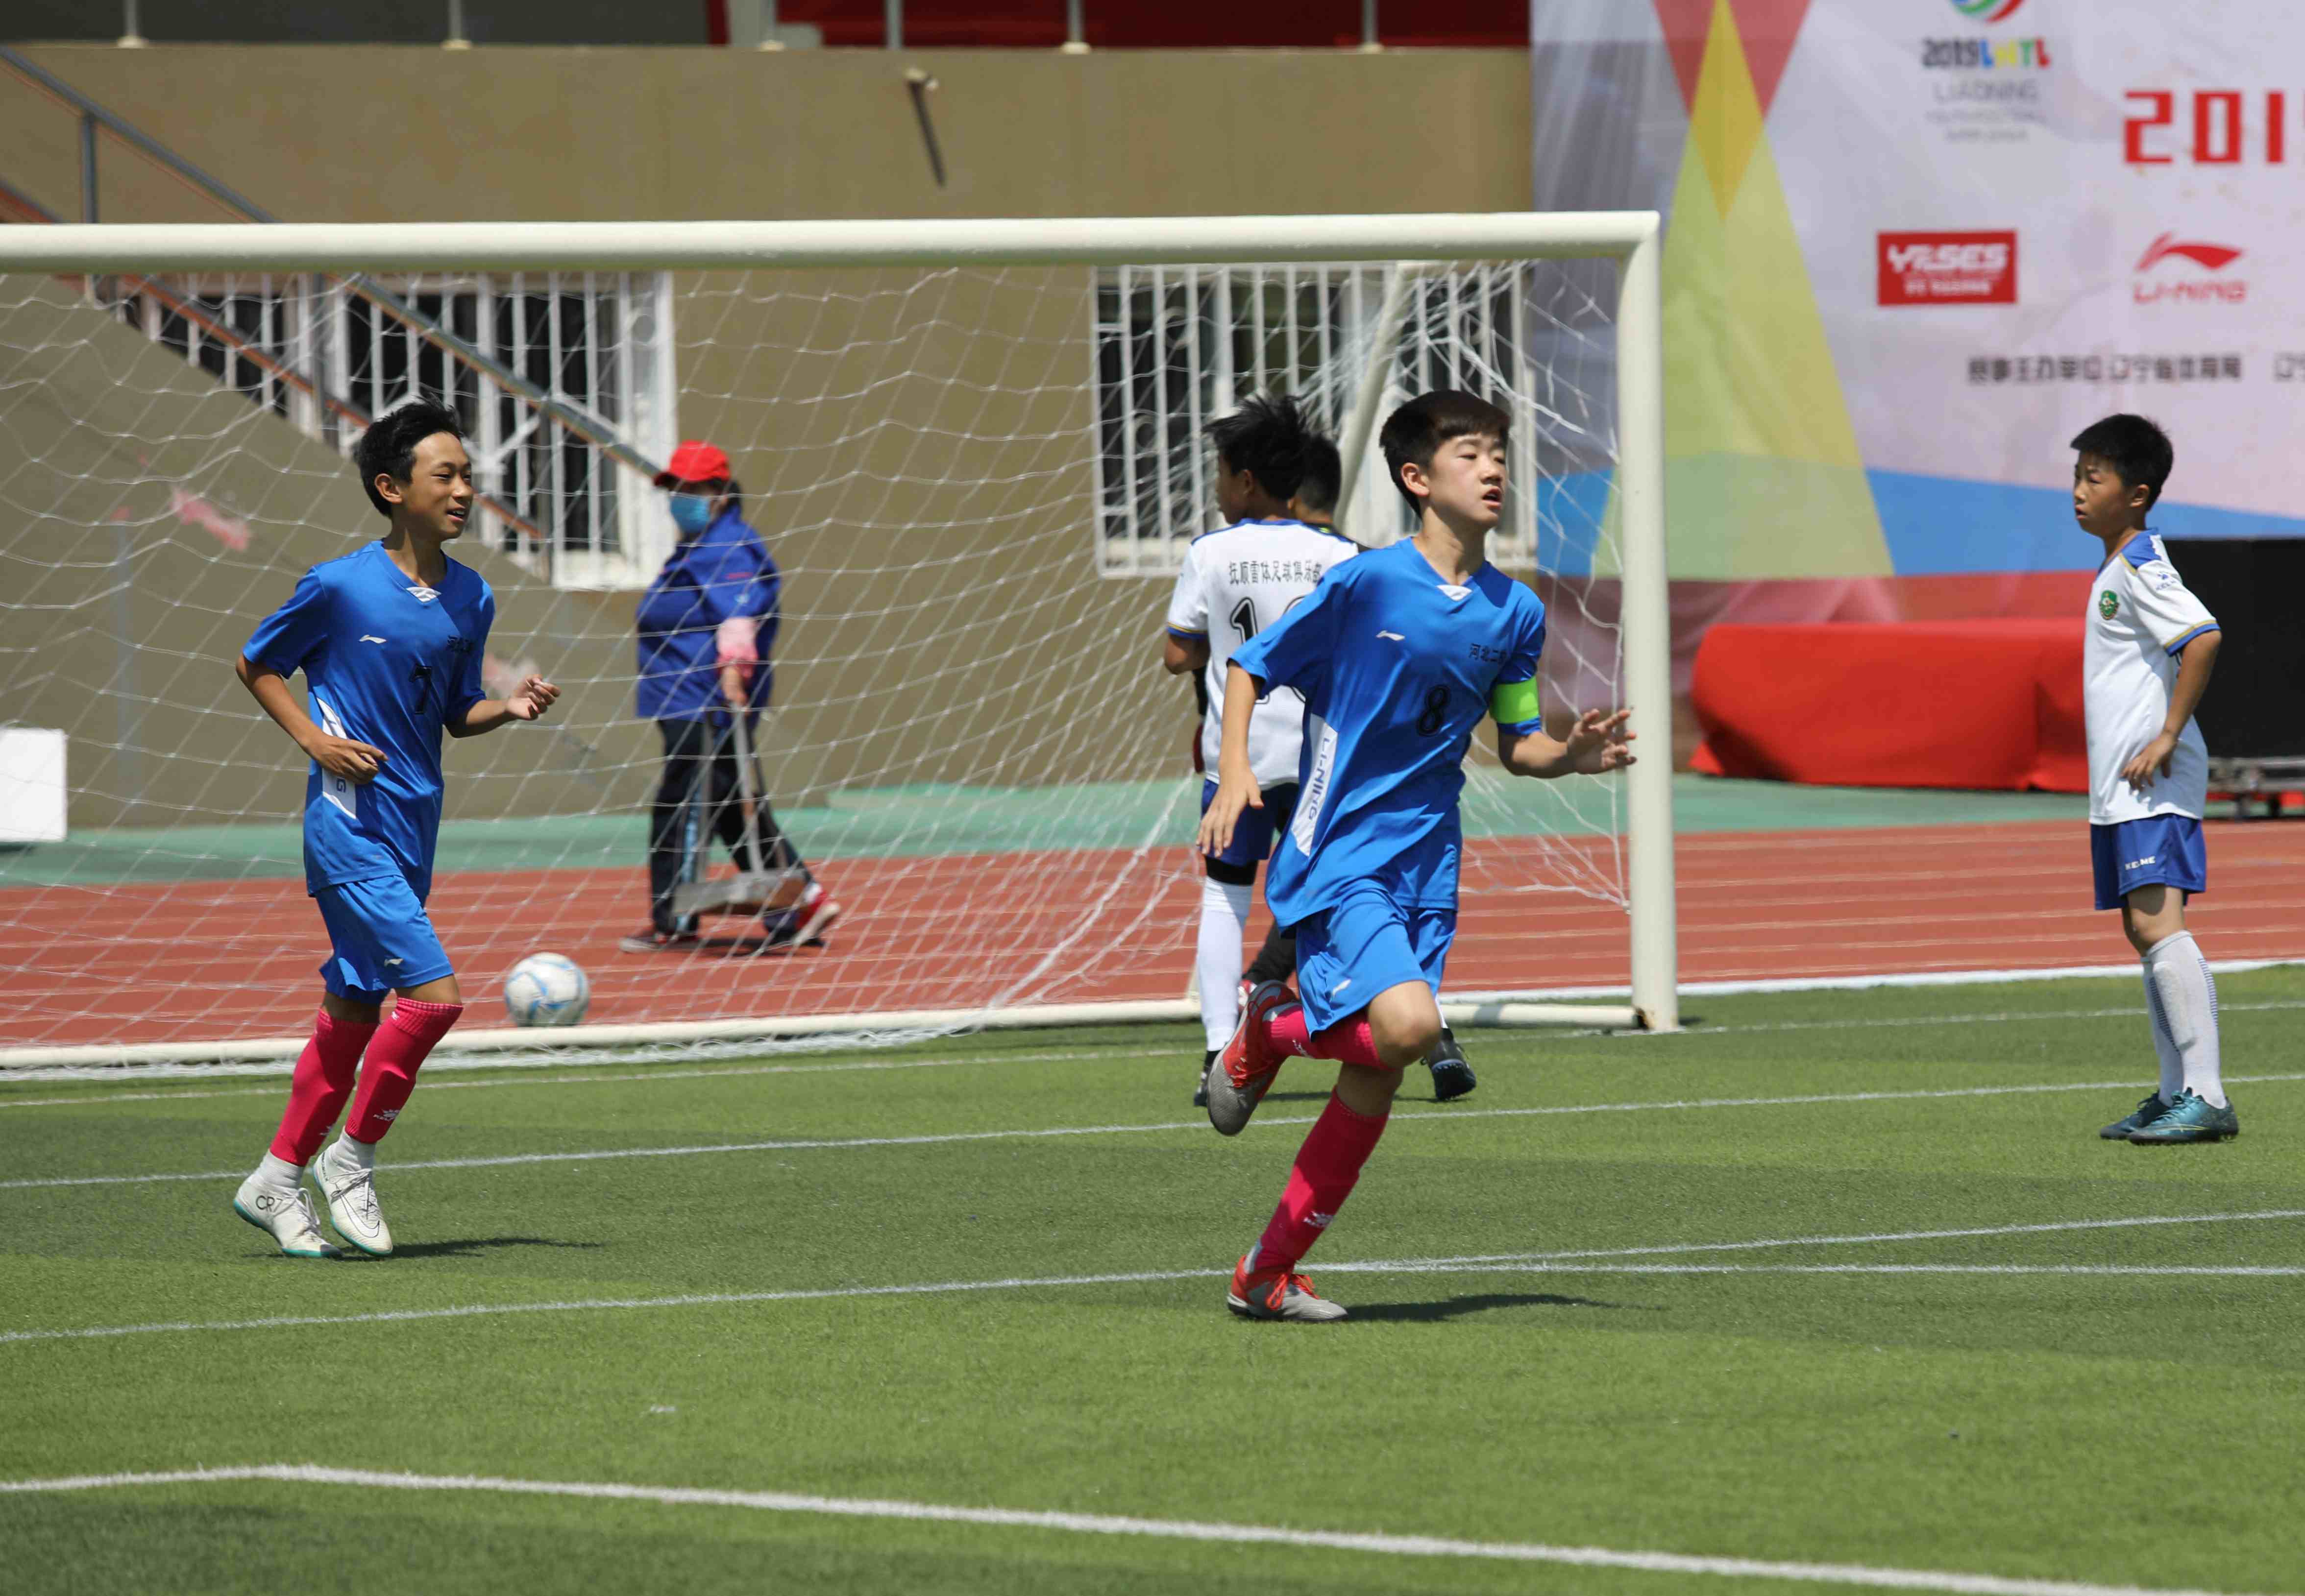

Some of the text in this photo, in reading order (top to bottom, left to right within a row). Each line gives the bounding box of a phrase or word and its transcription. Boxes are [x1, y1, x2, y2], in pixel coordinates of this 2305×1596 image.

[2124, 91, 2305, 164] 201
[408, 666, 432, 714] 7
[1417, 685, 1450, 737] 8
[256, 1195, 283, 1212] CR7
